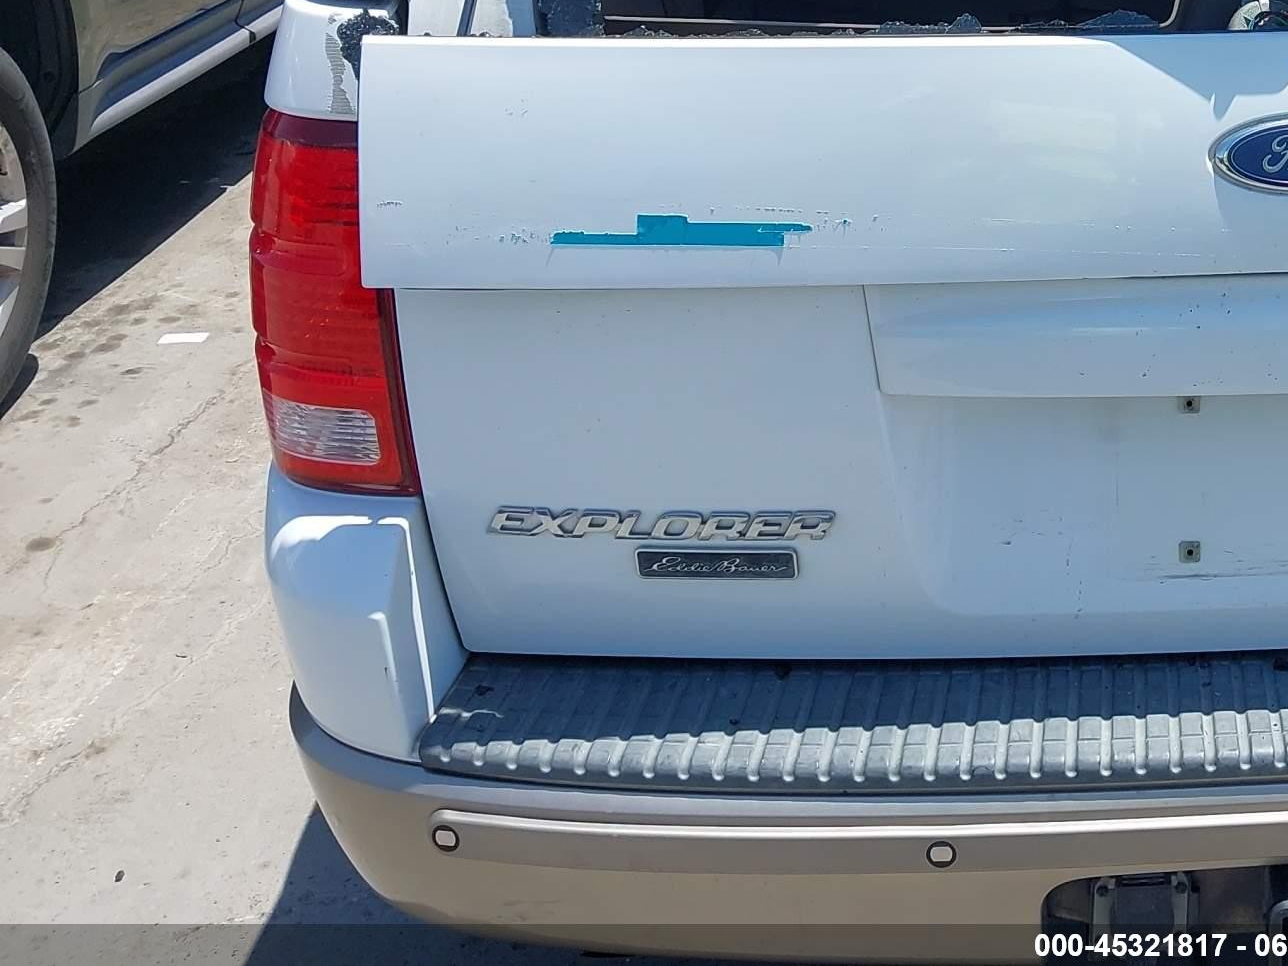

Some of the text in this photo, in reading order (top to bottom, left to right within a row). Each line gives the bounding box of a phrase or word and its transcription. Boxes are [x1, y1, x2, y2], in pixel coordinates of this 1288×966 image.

[488, 506, 836, 541] EXPLORER
[644, 556, 788, 573] Eddie Bauer
